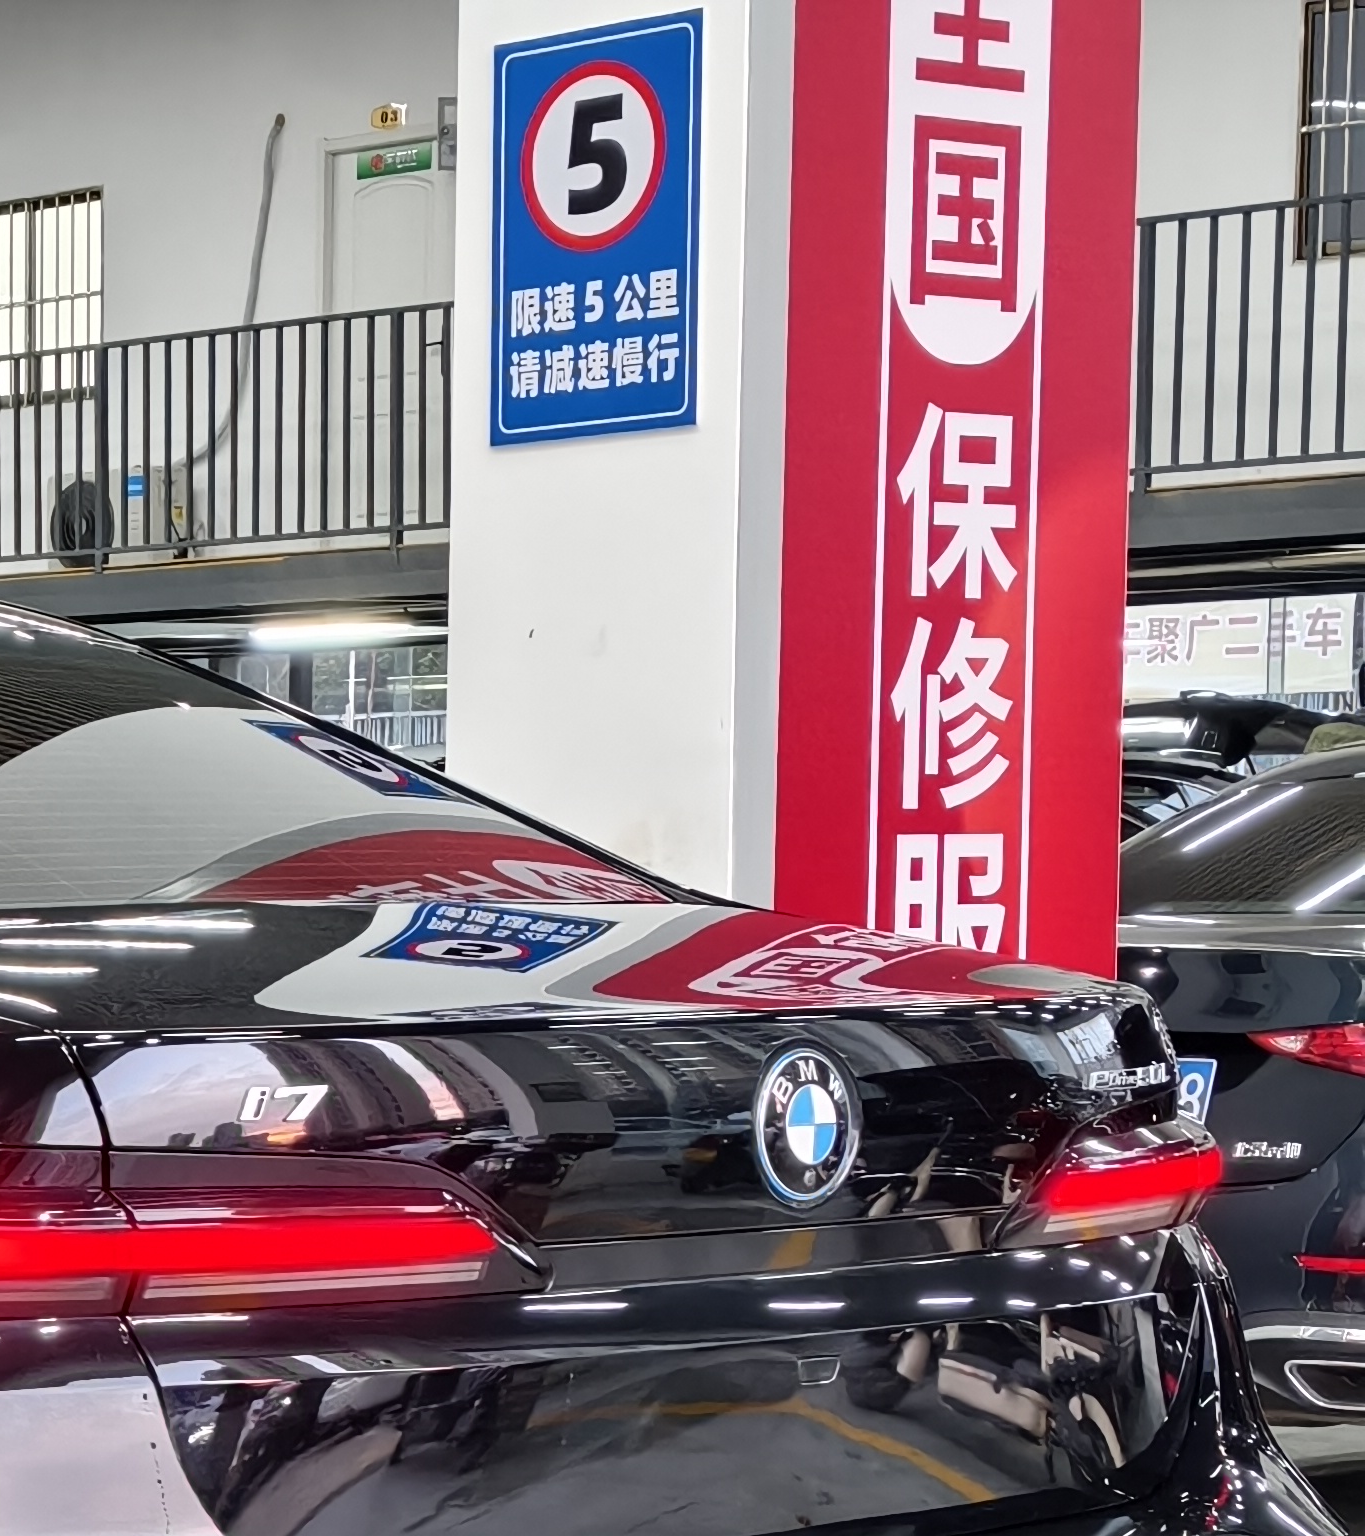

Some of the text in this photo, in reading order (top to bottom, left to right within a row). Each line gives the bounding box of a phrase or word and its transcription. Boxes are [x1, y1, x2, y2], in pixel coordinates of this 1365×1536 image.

[567, 93, 628, 216] 5
[509, 333, 680, 399] 请减速慢行
[890, 402, 1018, 956] 保修服
[239, 1085, 329, 1121] i7
[772, 1059, 846, 1104] BMW
